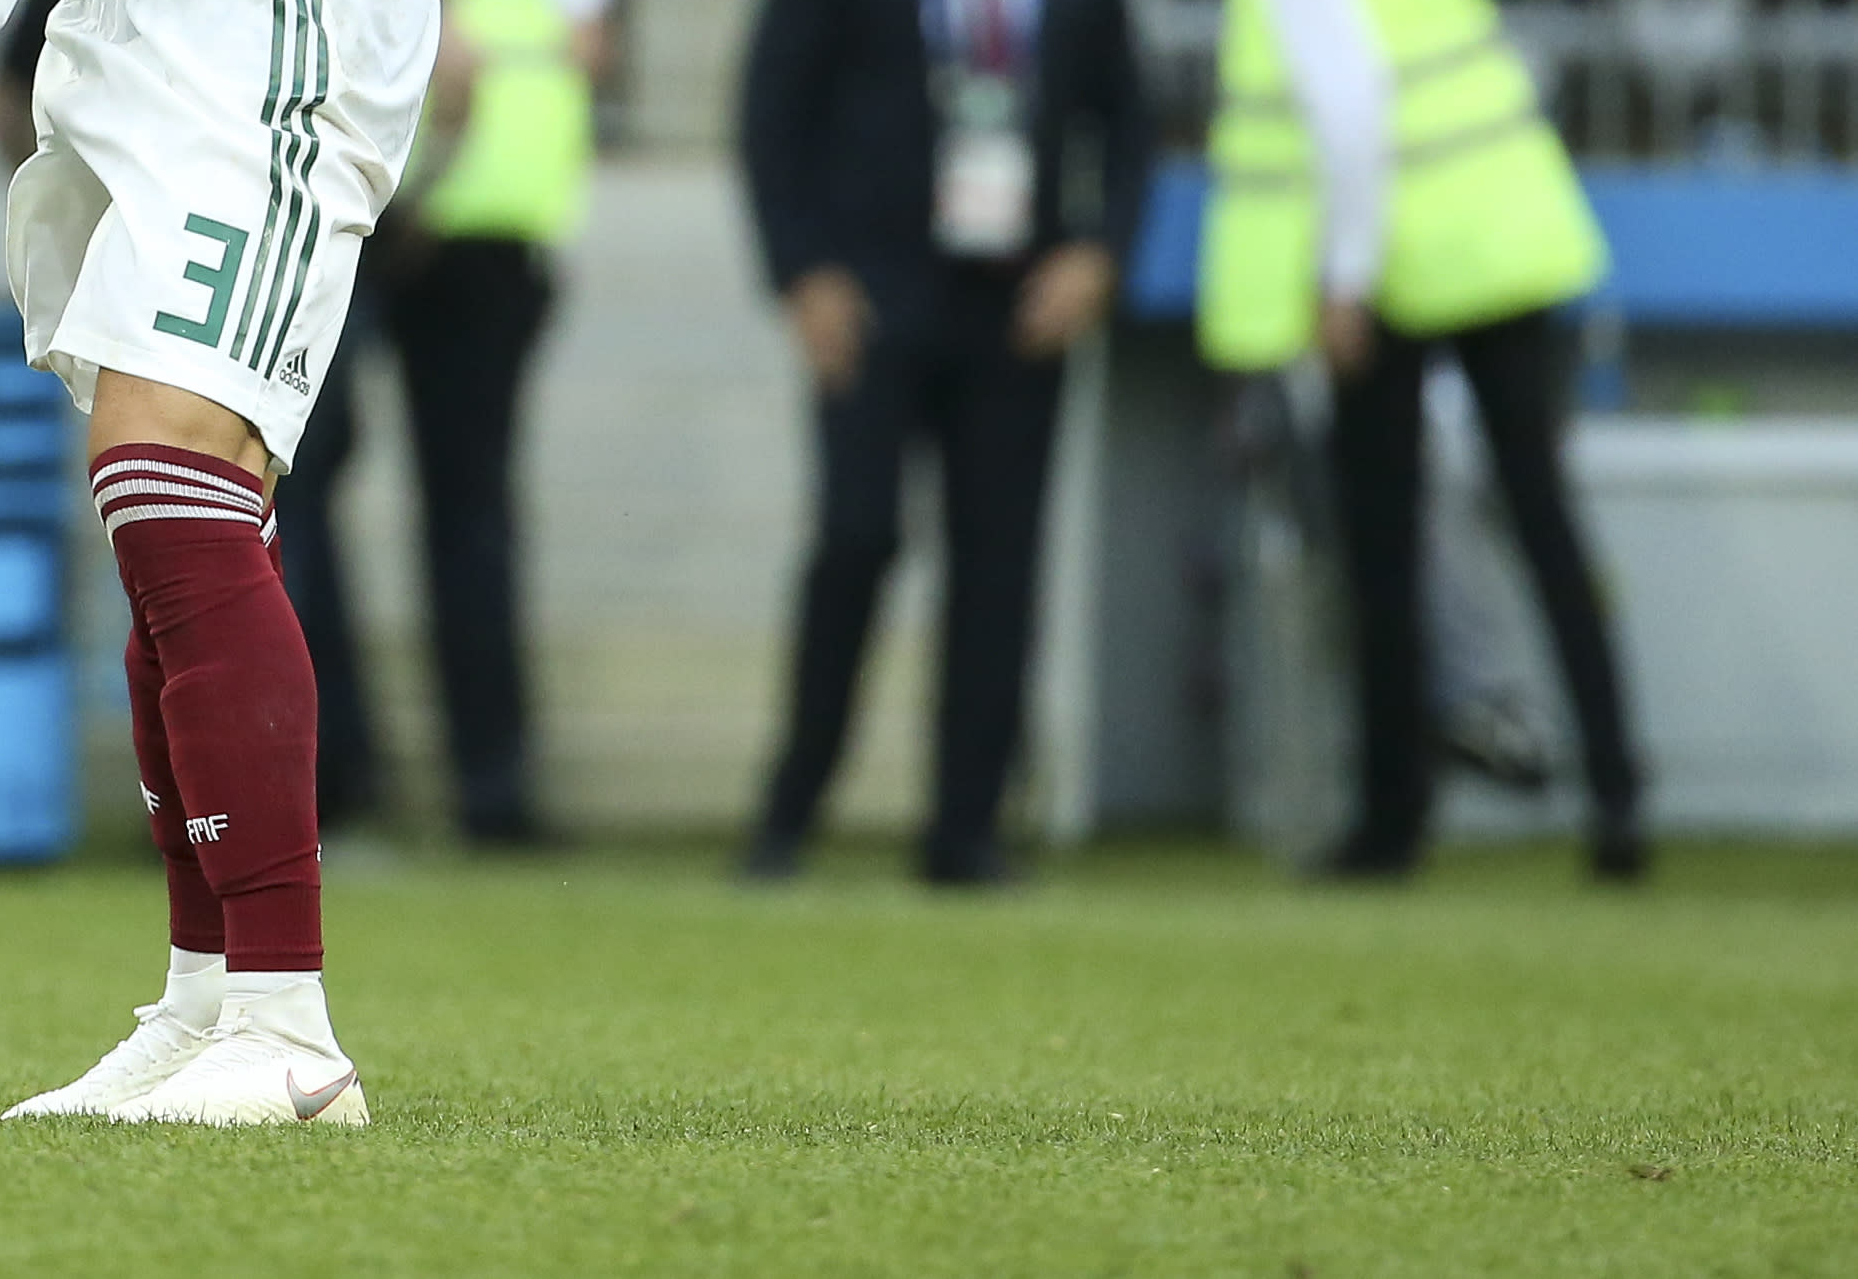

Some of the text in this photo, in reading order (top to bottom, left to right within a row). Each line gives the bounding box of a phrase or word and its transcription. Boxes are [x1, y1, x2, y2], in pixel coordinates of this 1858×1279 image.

[152, 212, 250, 349] 3
[279, 368, 311, 397] adidas
[185, 813, 229, 845] FMF
